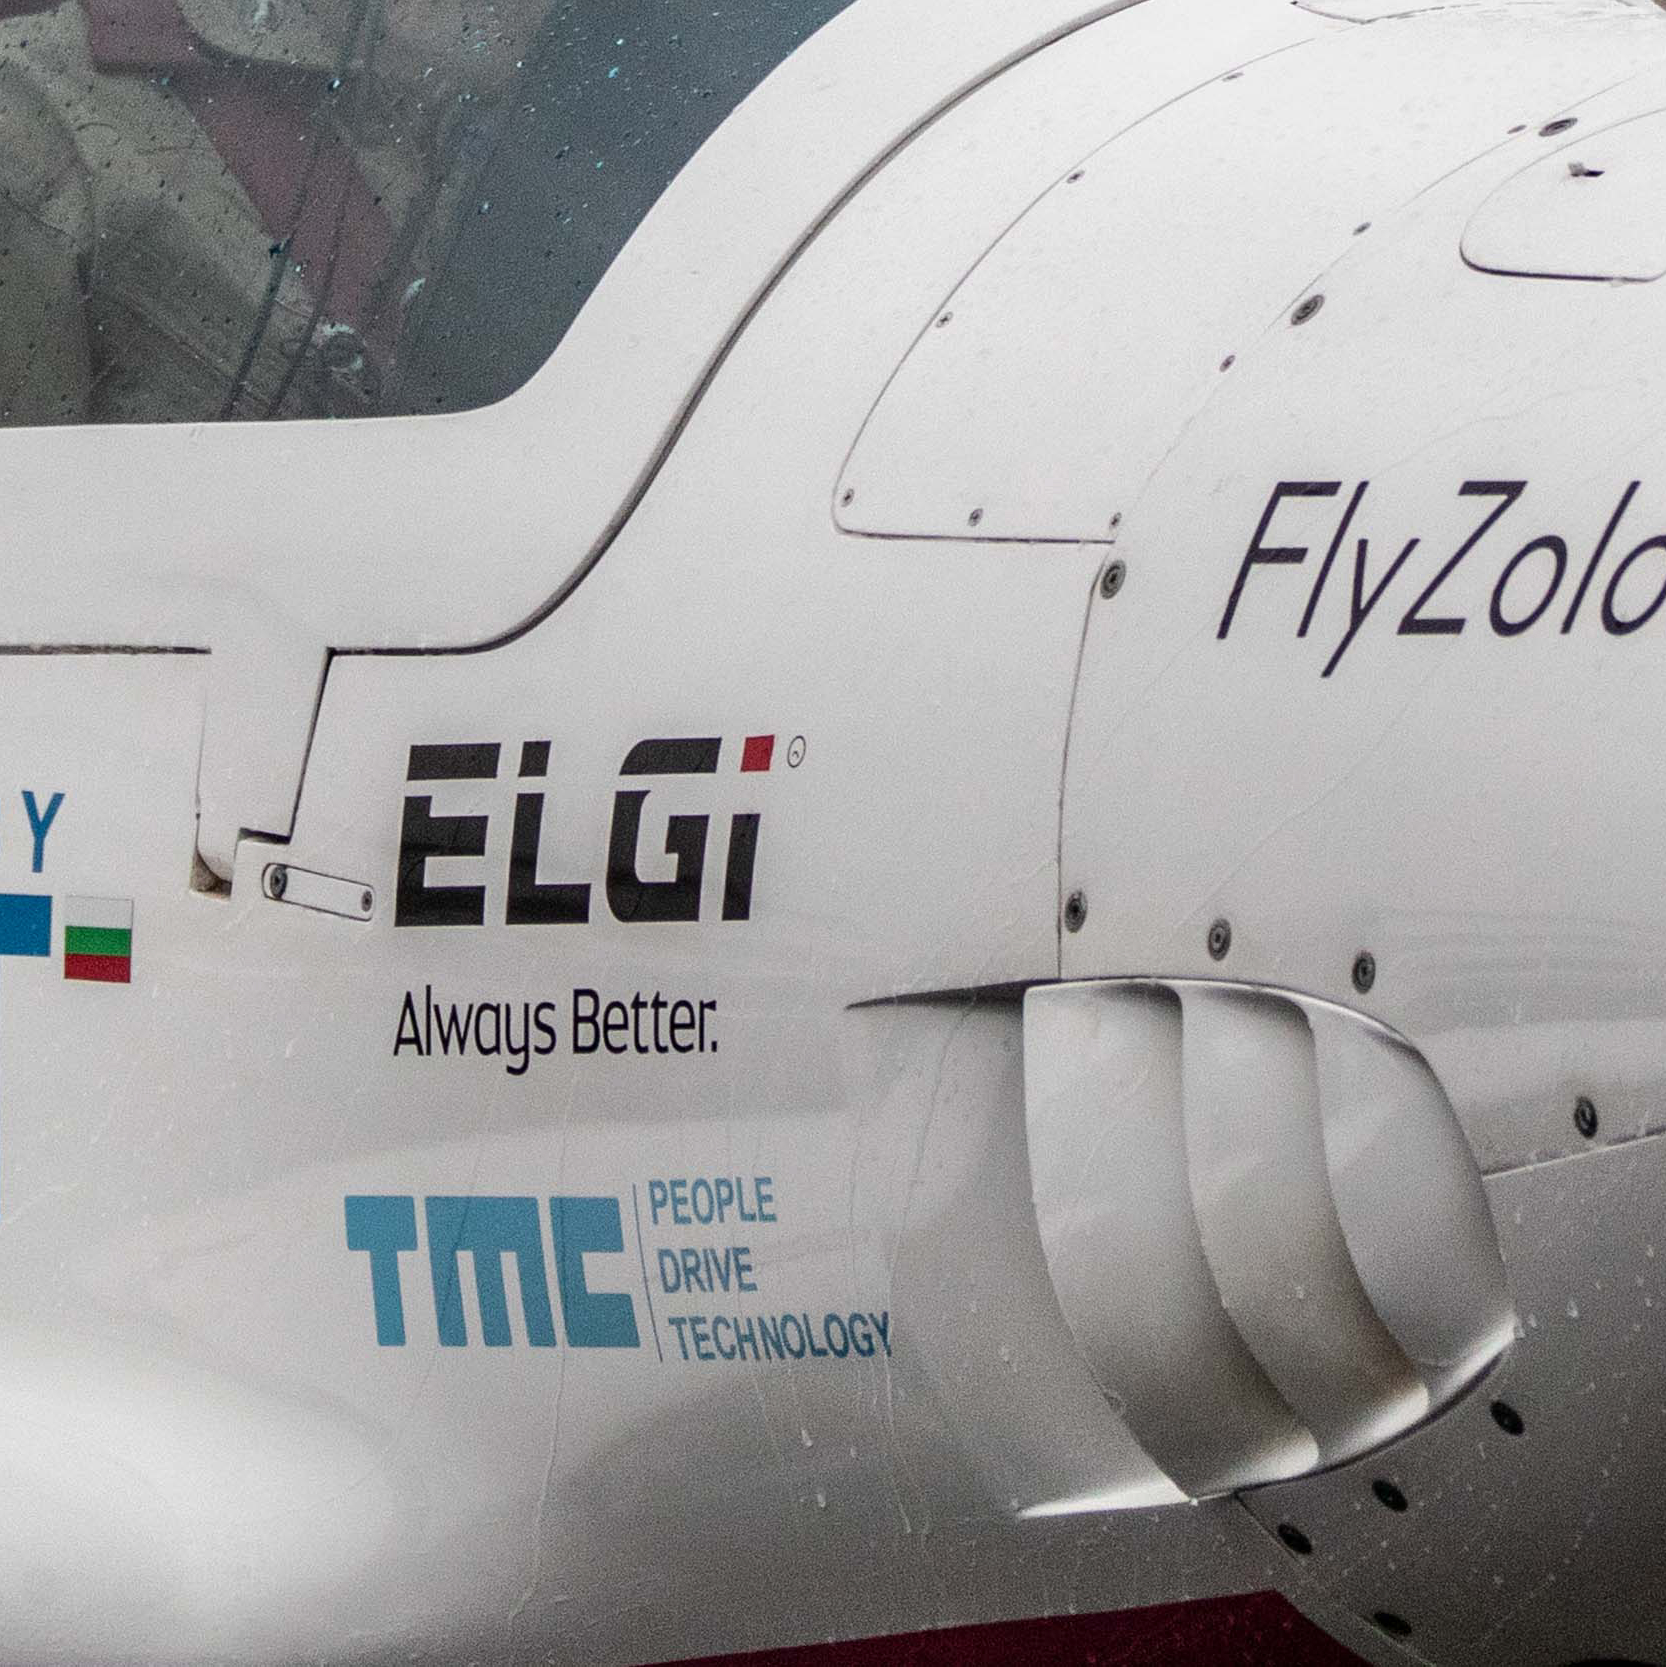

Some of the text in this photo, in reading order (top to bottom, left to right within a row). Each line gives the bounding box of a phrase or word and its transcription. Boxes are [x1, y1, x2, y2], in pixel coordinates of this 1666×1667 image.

[392, 984, 720, 1077] Always Better.
[648, 1176, 778, 1225] PEOPLE
[344, 1195, 641, 1349] TMC
[657, 1246, 759, 1294] DRIVE
[668, 1311, 894, 1361] TECHNOLOGY
